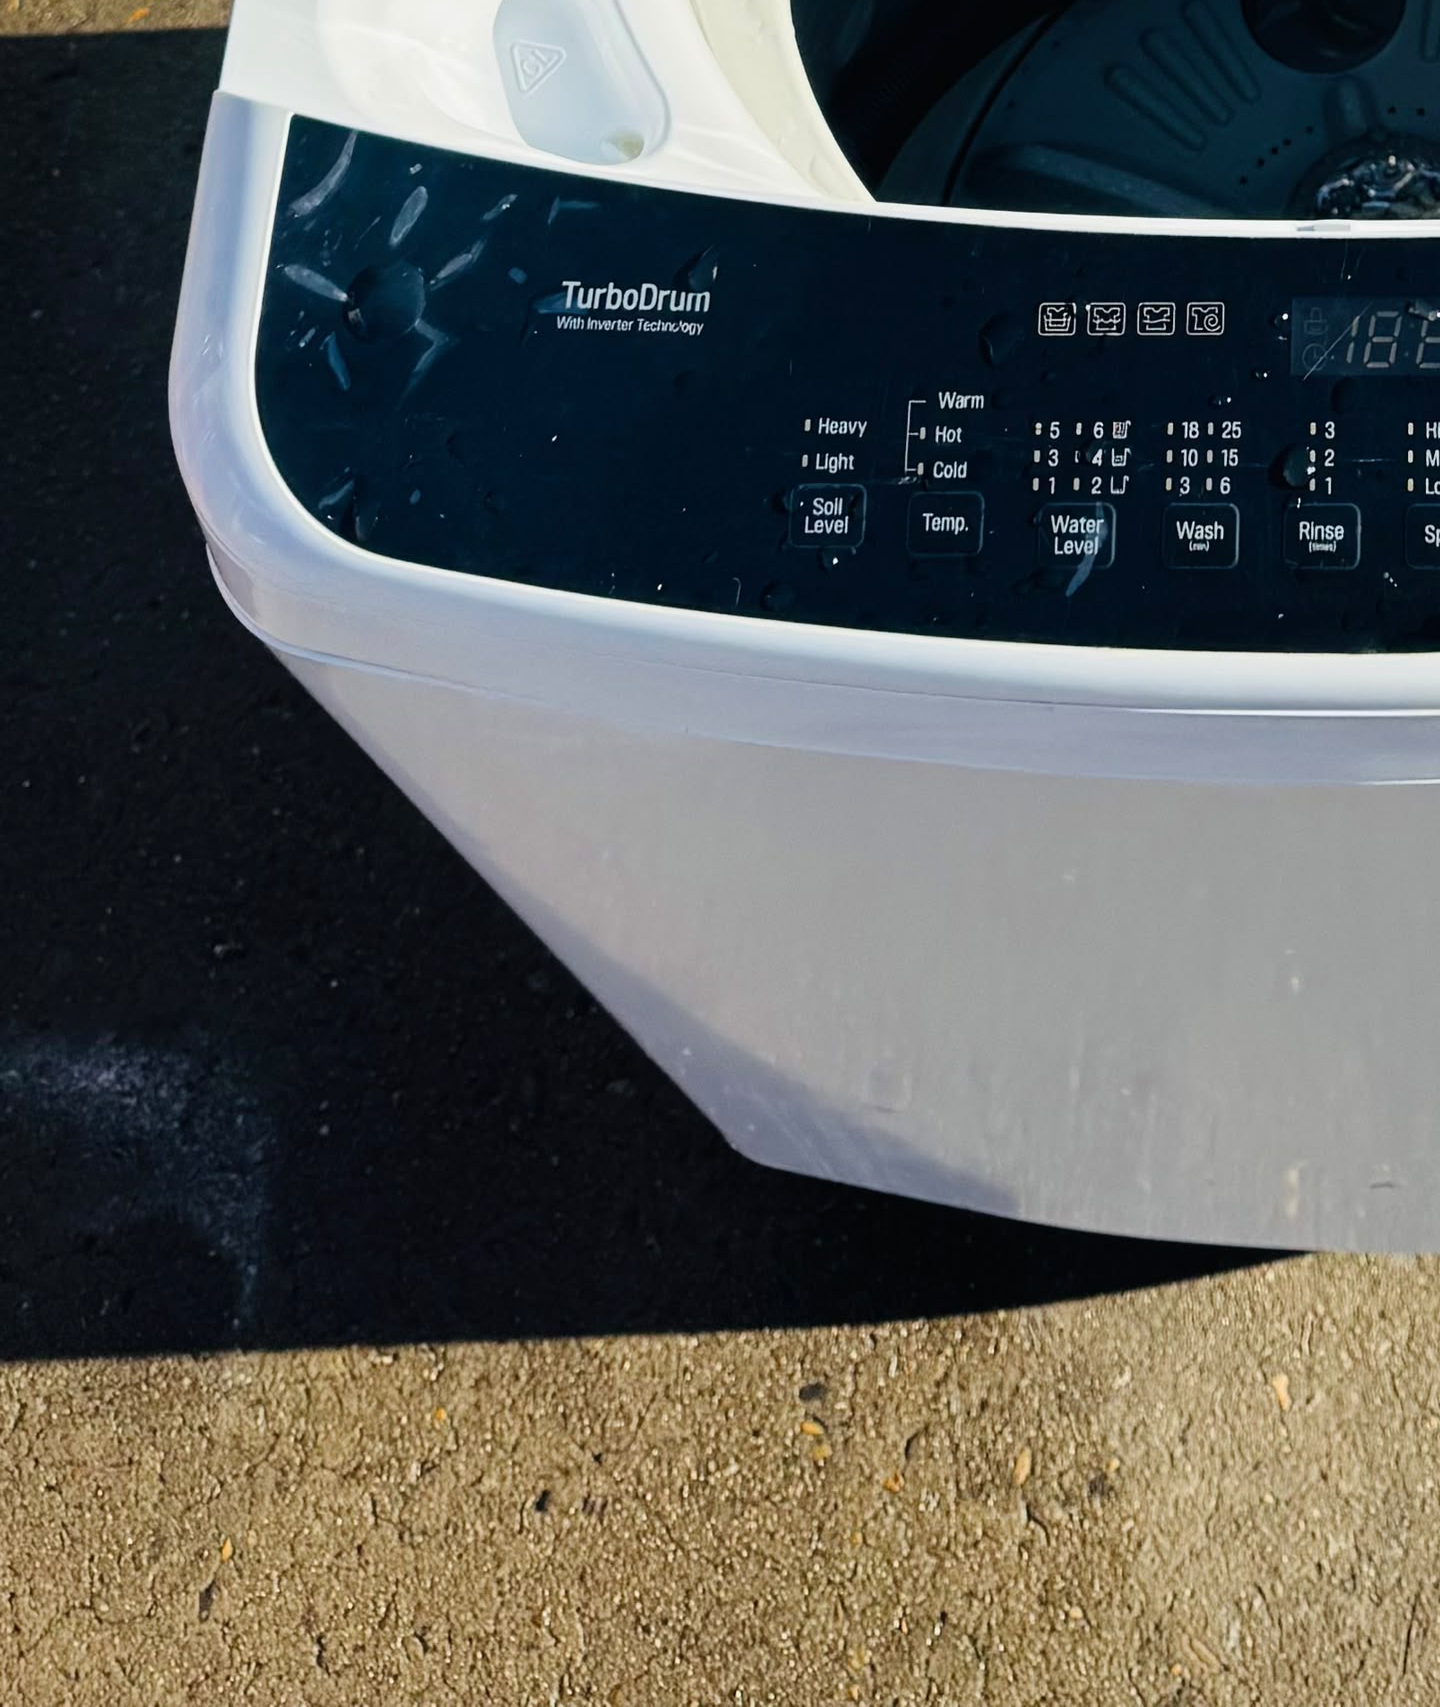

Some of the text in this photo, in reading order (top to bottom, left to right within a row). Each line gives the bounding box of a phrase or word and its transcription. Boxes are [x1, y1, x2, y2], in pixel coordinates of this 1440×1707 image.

[562, 281, 710, 313] TurboDrum
[557, 315, 584, 330] With
[587, 317, 634, 331] Inverter
[938, 391, 985, 410] Warm
[818, 417, 868, 438] Heavy
[935, 426, 963, 443] Hot
[1050, 421, 1104, 439] 5 6
[1182, 421, 1242, 439] 18 25
[1324, 421, 1335, 439] 3
[815, 453, 855, 474] Light
[1048, 448, 1103, 467] 3 4
[1181, 448, 1239, 467] 10 15
[1324, 449, 1335, 467] 2
[933, 461, 968, 479] Cold
[1048, 476, 1102, 495] 1 2
[1179, 476, 1231, 495] 3 6
[1325, 477, 1332, 495] 1
[812, 497, 843, 516] Soil
[804, 516, 849, 535] Level
[922, 512, 969, 535] Temp.
[1050, 515, 1104, 534] Water
[1176, 521, 1224, 540] Wash
[1299, 521, 1345, 541] Rinse
[1054, 536, 1099, 555] Level
